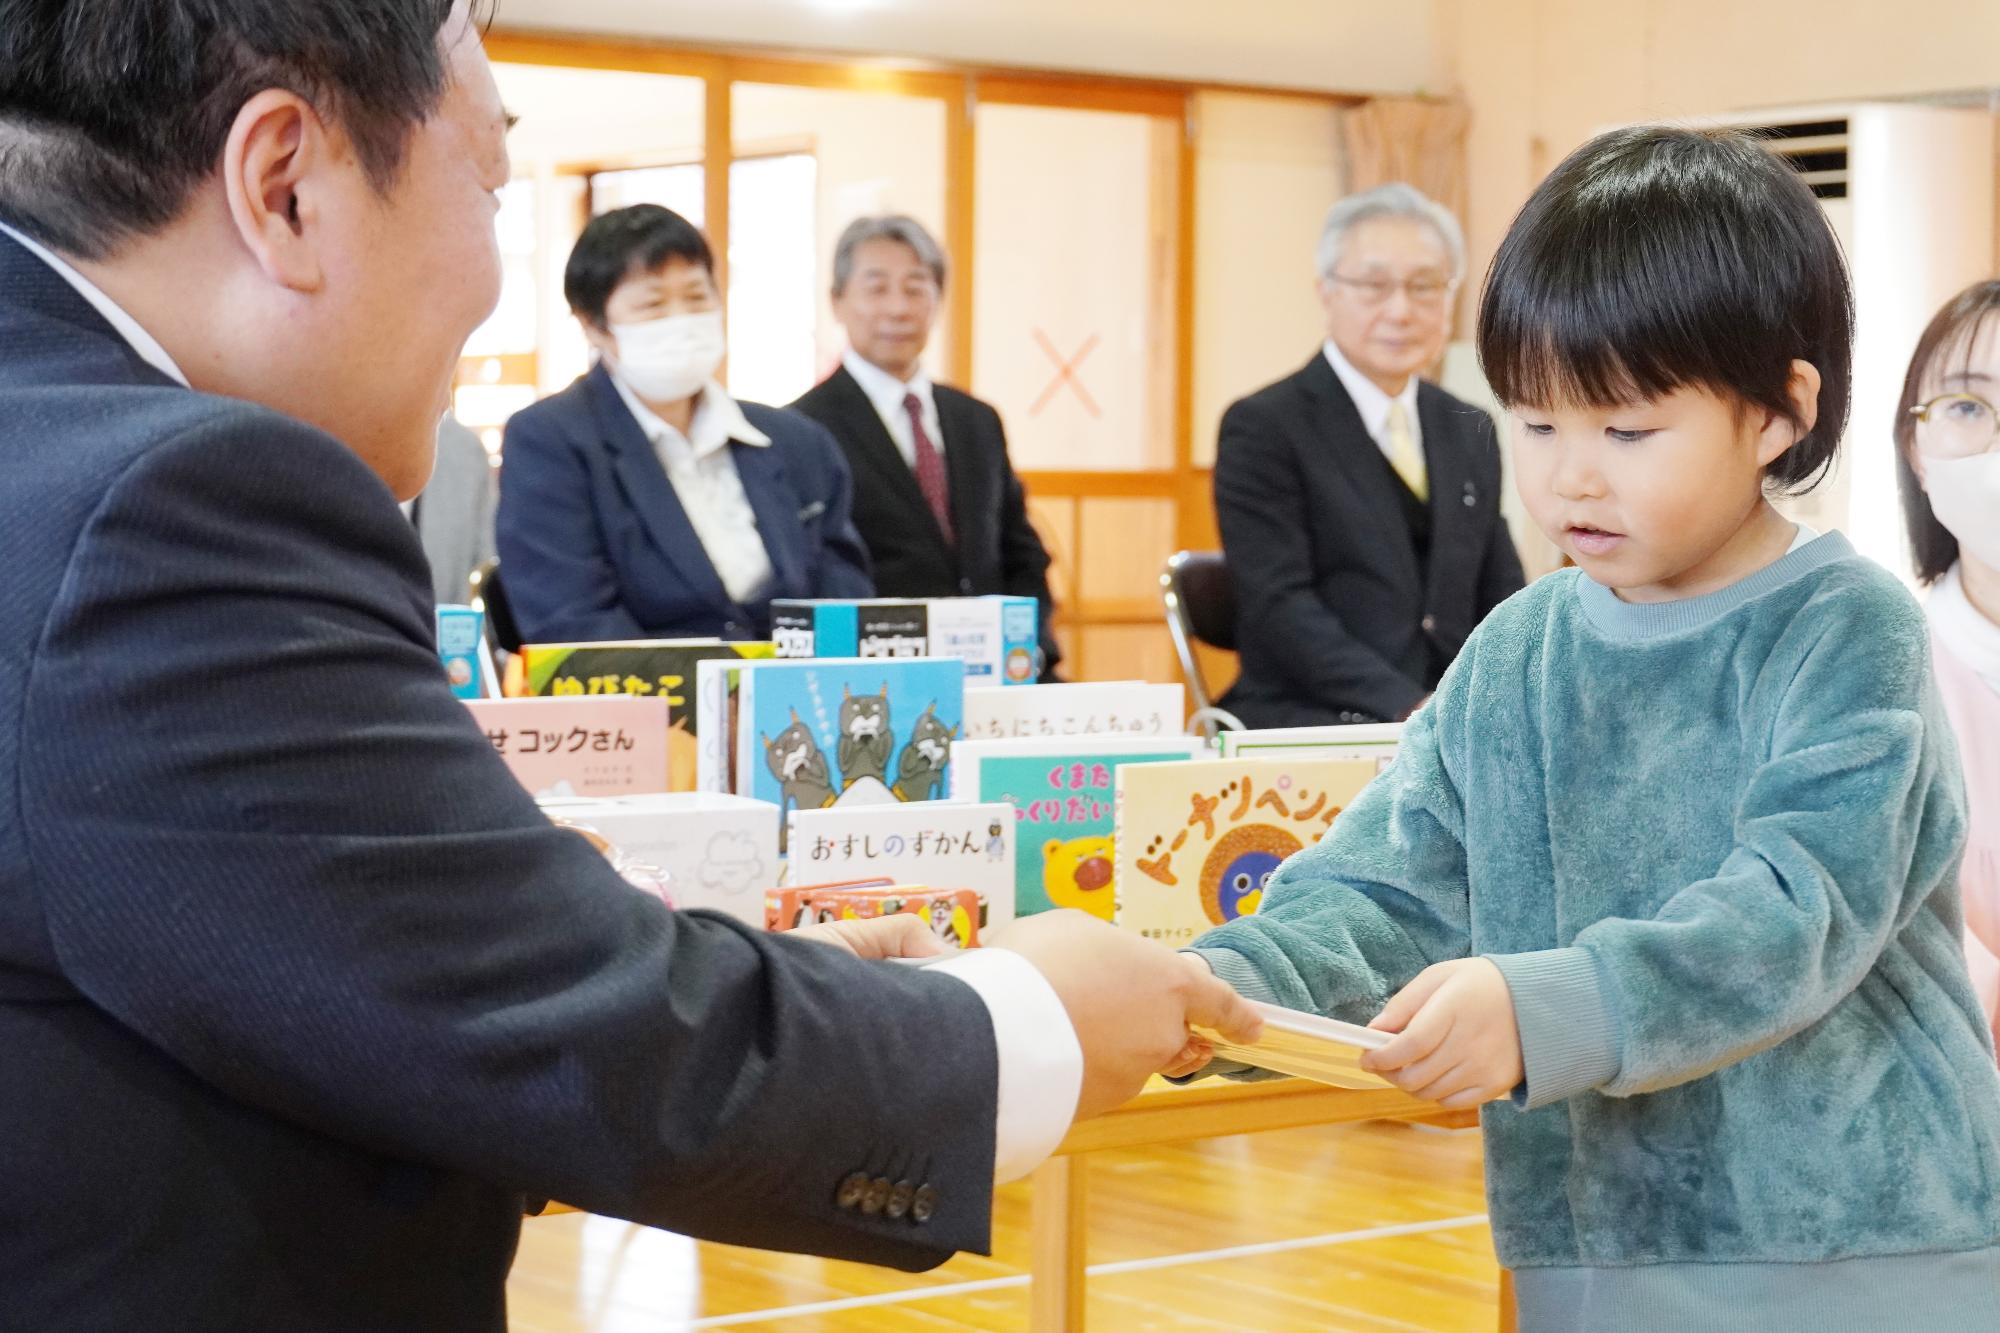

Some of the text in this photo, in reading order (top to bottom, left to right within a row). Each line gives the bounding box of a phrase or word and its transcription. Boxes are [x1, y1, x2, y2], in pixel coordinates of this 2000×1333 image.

[518, 725, 635, 754] コックさん
[810, 828, 981, 861] おすしのずかん
